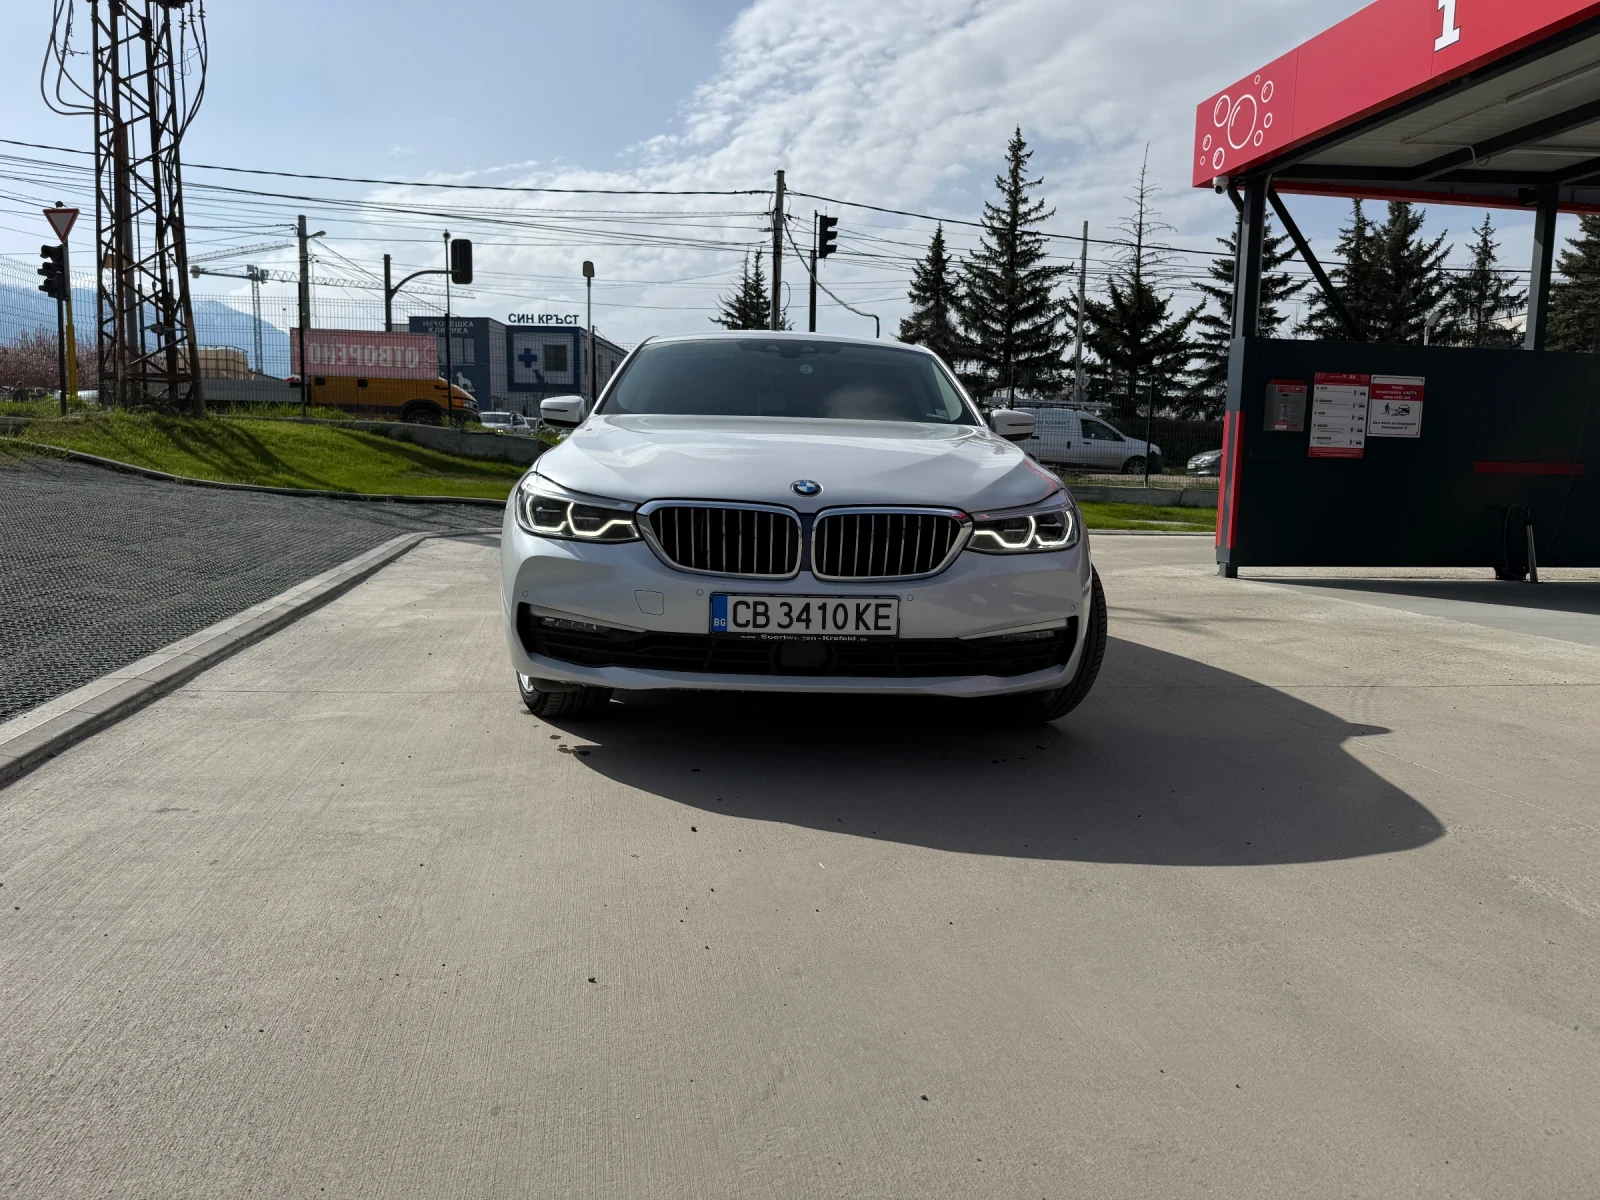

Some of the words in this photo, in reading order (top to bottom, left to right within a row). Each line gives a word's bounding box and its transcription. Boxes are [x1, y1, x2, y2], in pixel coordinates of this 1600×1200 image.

[1434, 0, 1461, 53] 1
[422, 320, 474, 328] НЕЧОЕШКА
[508, 313, 534, 324] СИН
[538, 313, 579, 325] КРЪСТ
[713, 618, 726, 627] BG
